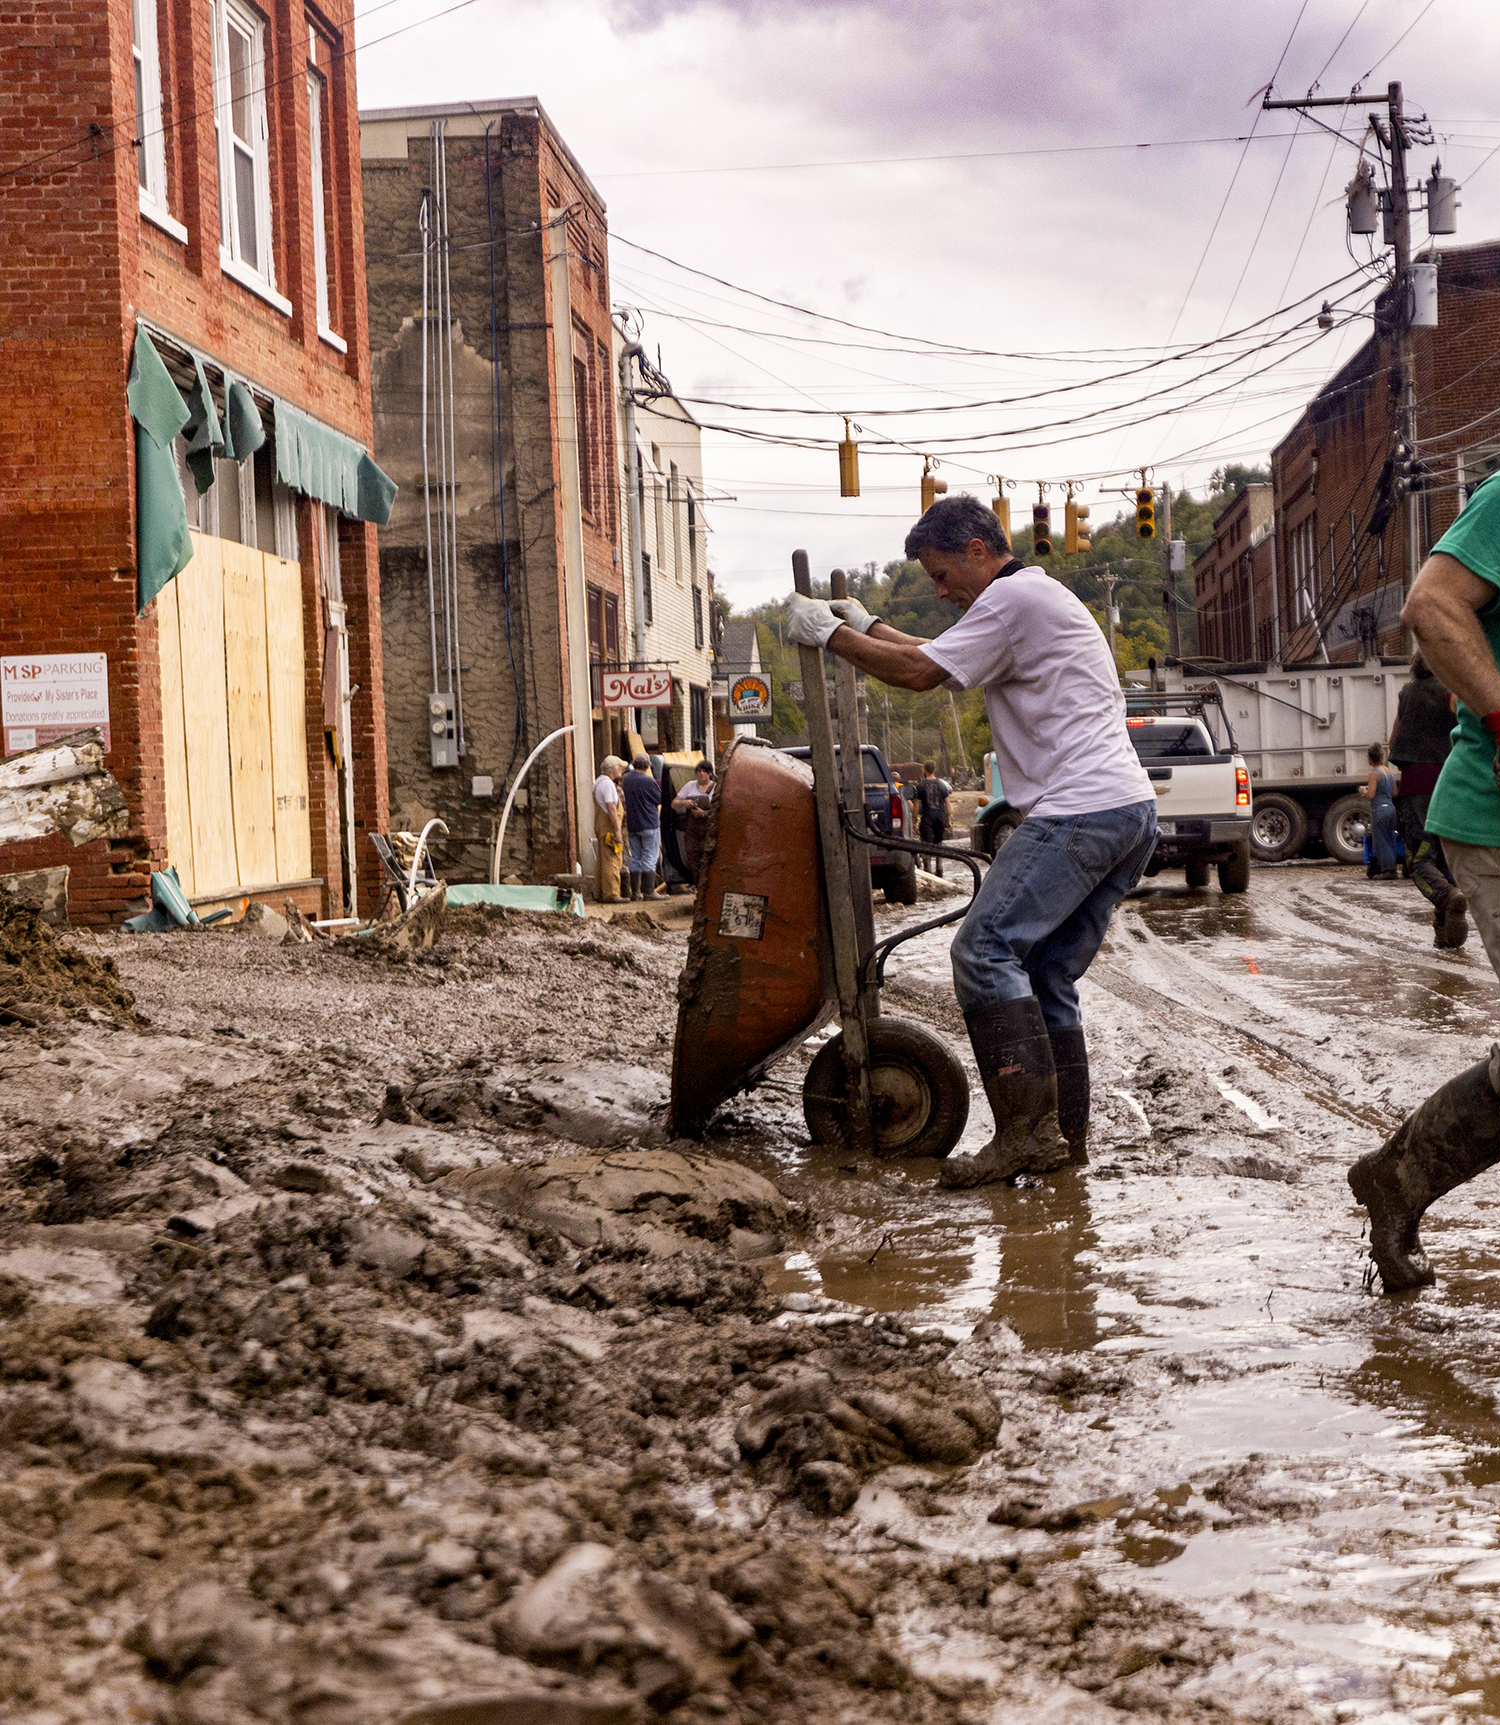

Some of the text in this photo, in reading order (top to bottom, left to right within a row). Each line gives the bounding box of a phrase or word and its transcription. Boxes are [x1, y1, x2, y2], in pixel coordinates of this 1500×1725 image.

[43, 662, 103, 675] PARKING
[7, 690, 34, 703] Provided
[45, 689, 54, 704] My
[56, 688, 79, 701] Sister's
[80, 687, 98, 700] Place
[604, 674, 670, 702] Mal's
[5, 708, 105, 723] Donations greatly appreciated
